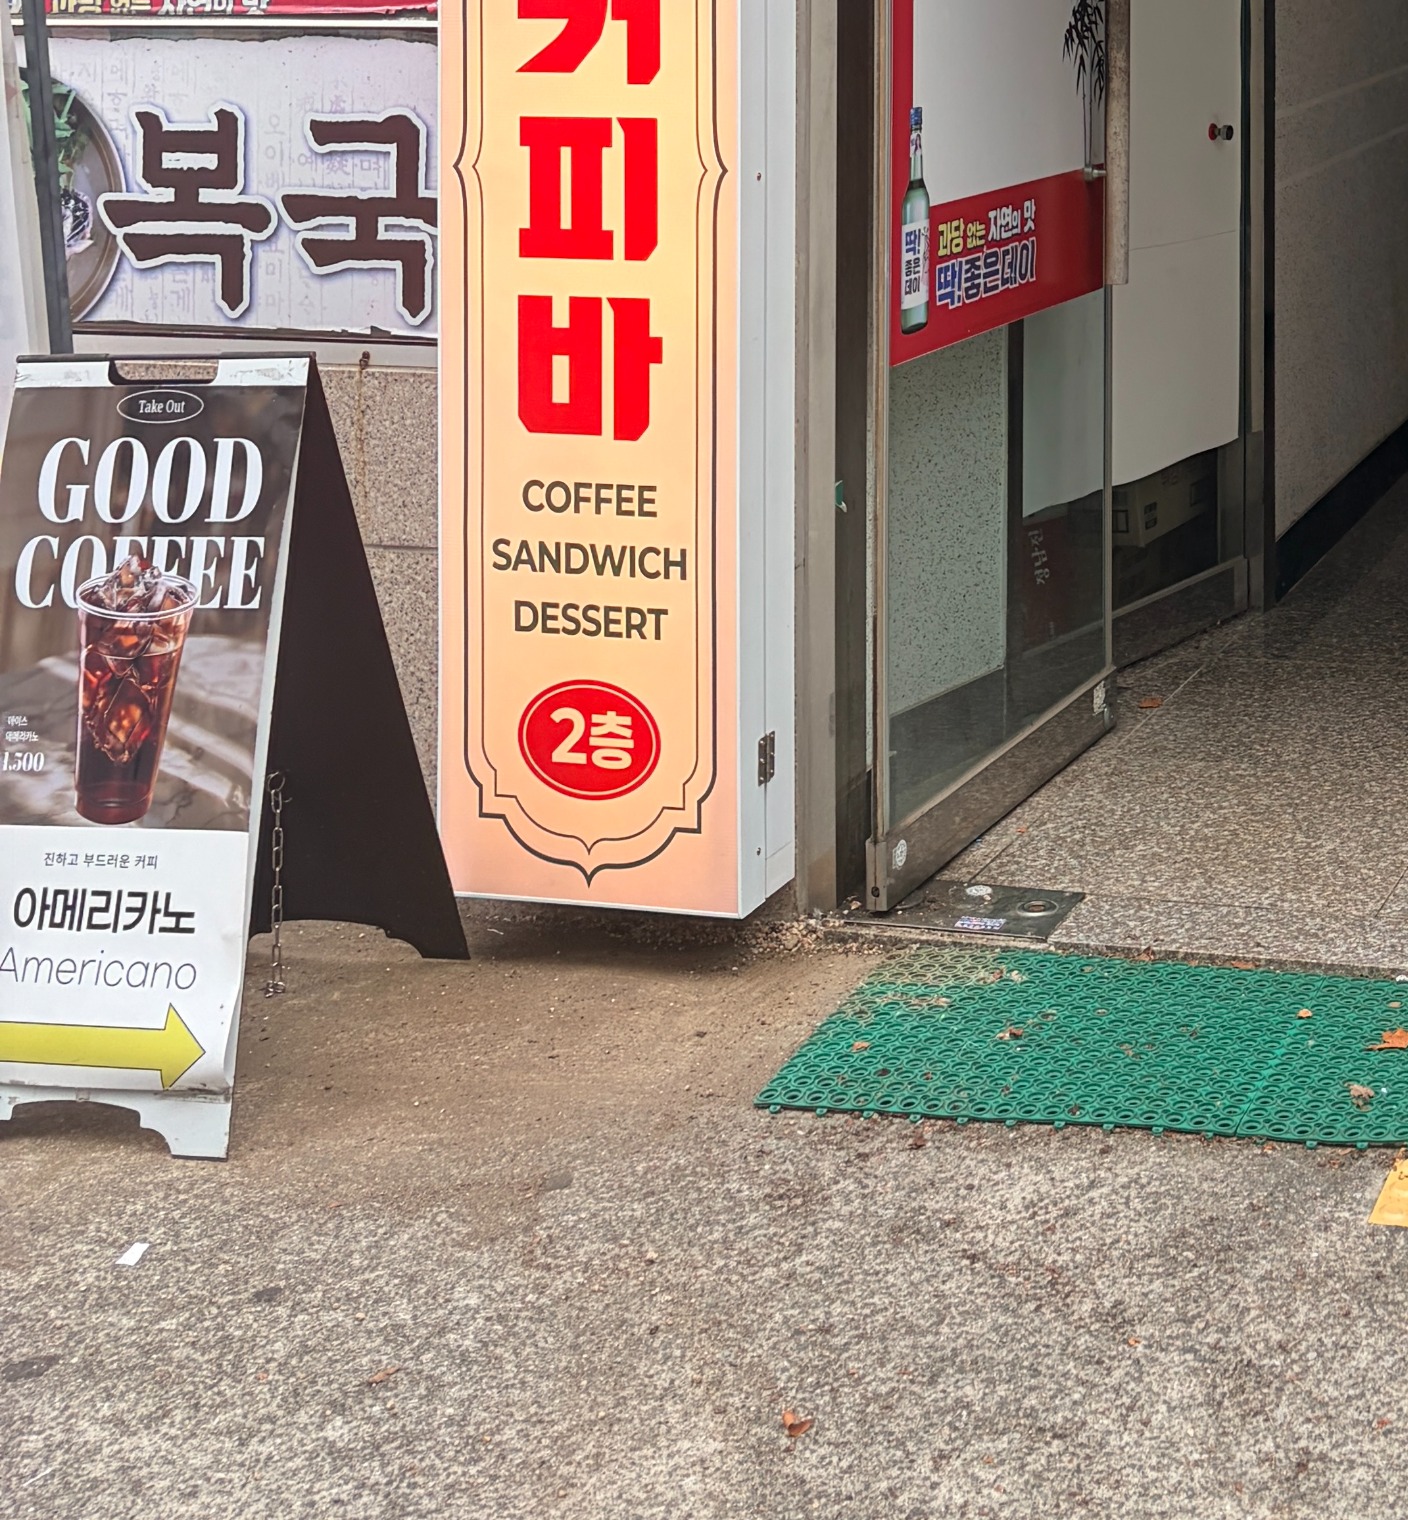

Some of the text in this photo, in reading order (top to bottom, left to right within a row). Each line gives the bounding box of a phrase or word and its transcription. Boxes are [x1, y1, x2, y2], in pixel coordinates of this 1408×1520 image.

[100, 106, 438, 320] 복국
[937, 198, 1036, 258] 과당 없는 자연의 맛
[138, 399, 185, 414] Take Out
[38, 437, 263, 524] GOOD
[521, 479, 658, 519] COFFEE
[491, 537, 688, 581] SANDWICH
[512, 599, 669, 642] DESSERT
[550, 707, 636, 771] 2층
[44, 852, 158, 869] 진하고 부드러운 커피
[14, 886, 196, 935] 아메리카노
[0, 946, 197, 990] Americano
